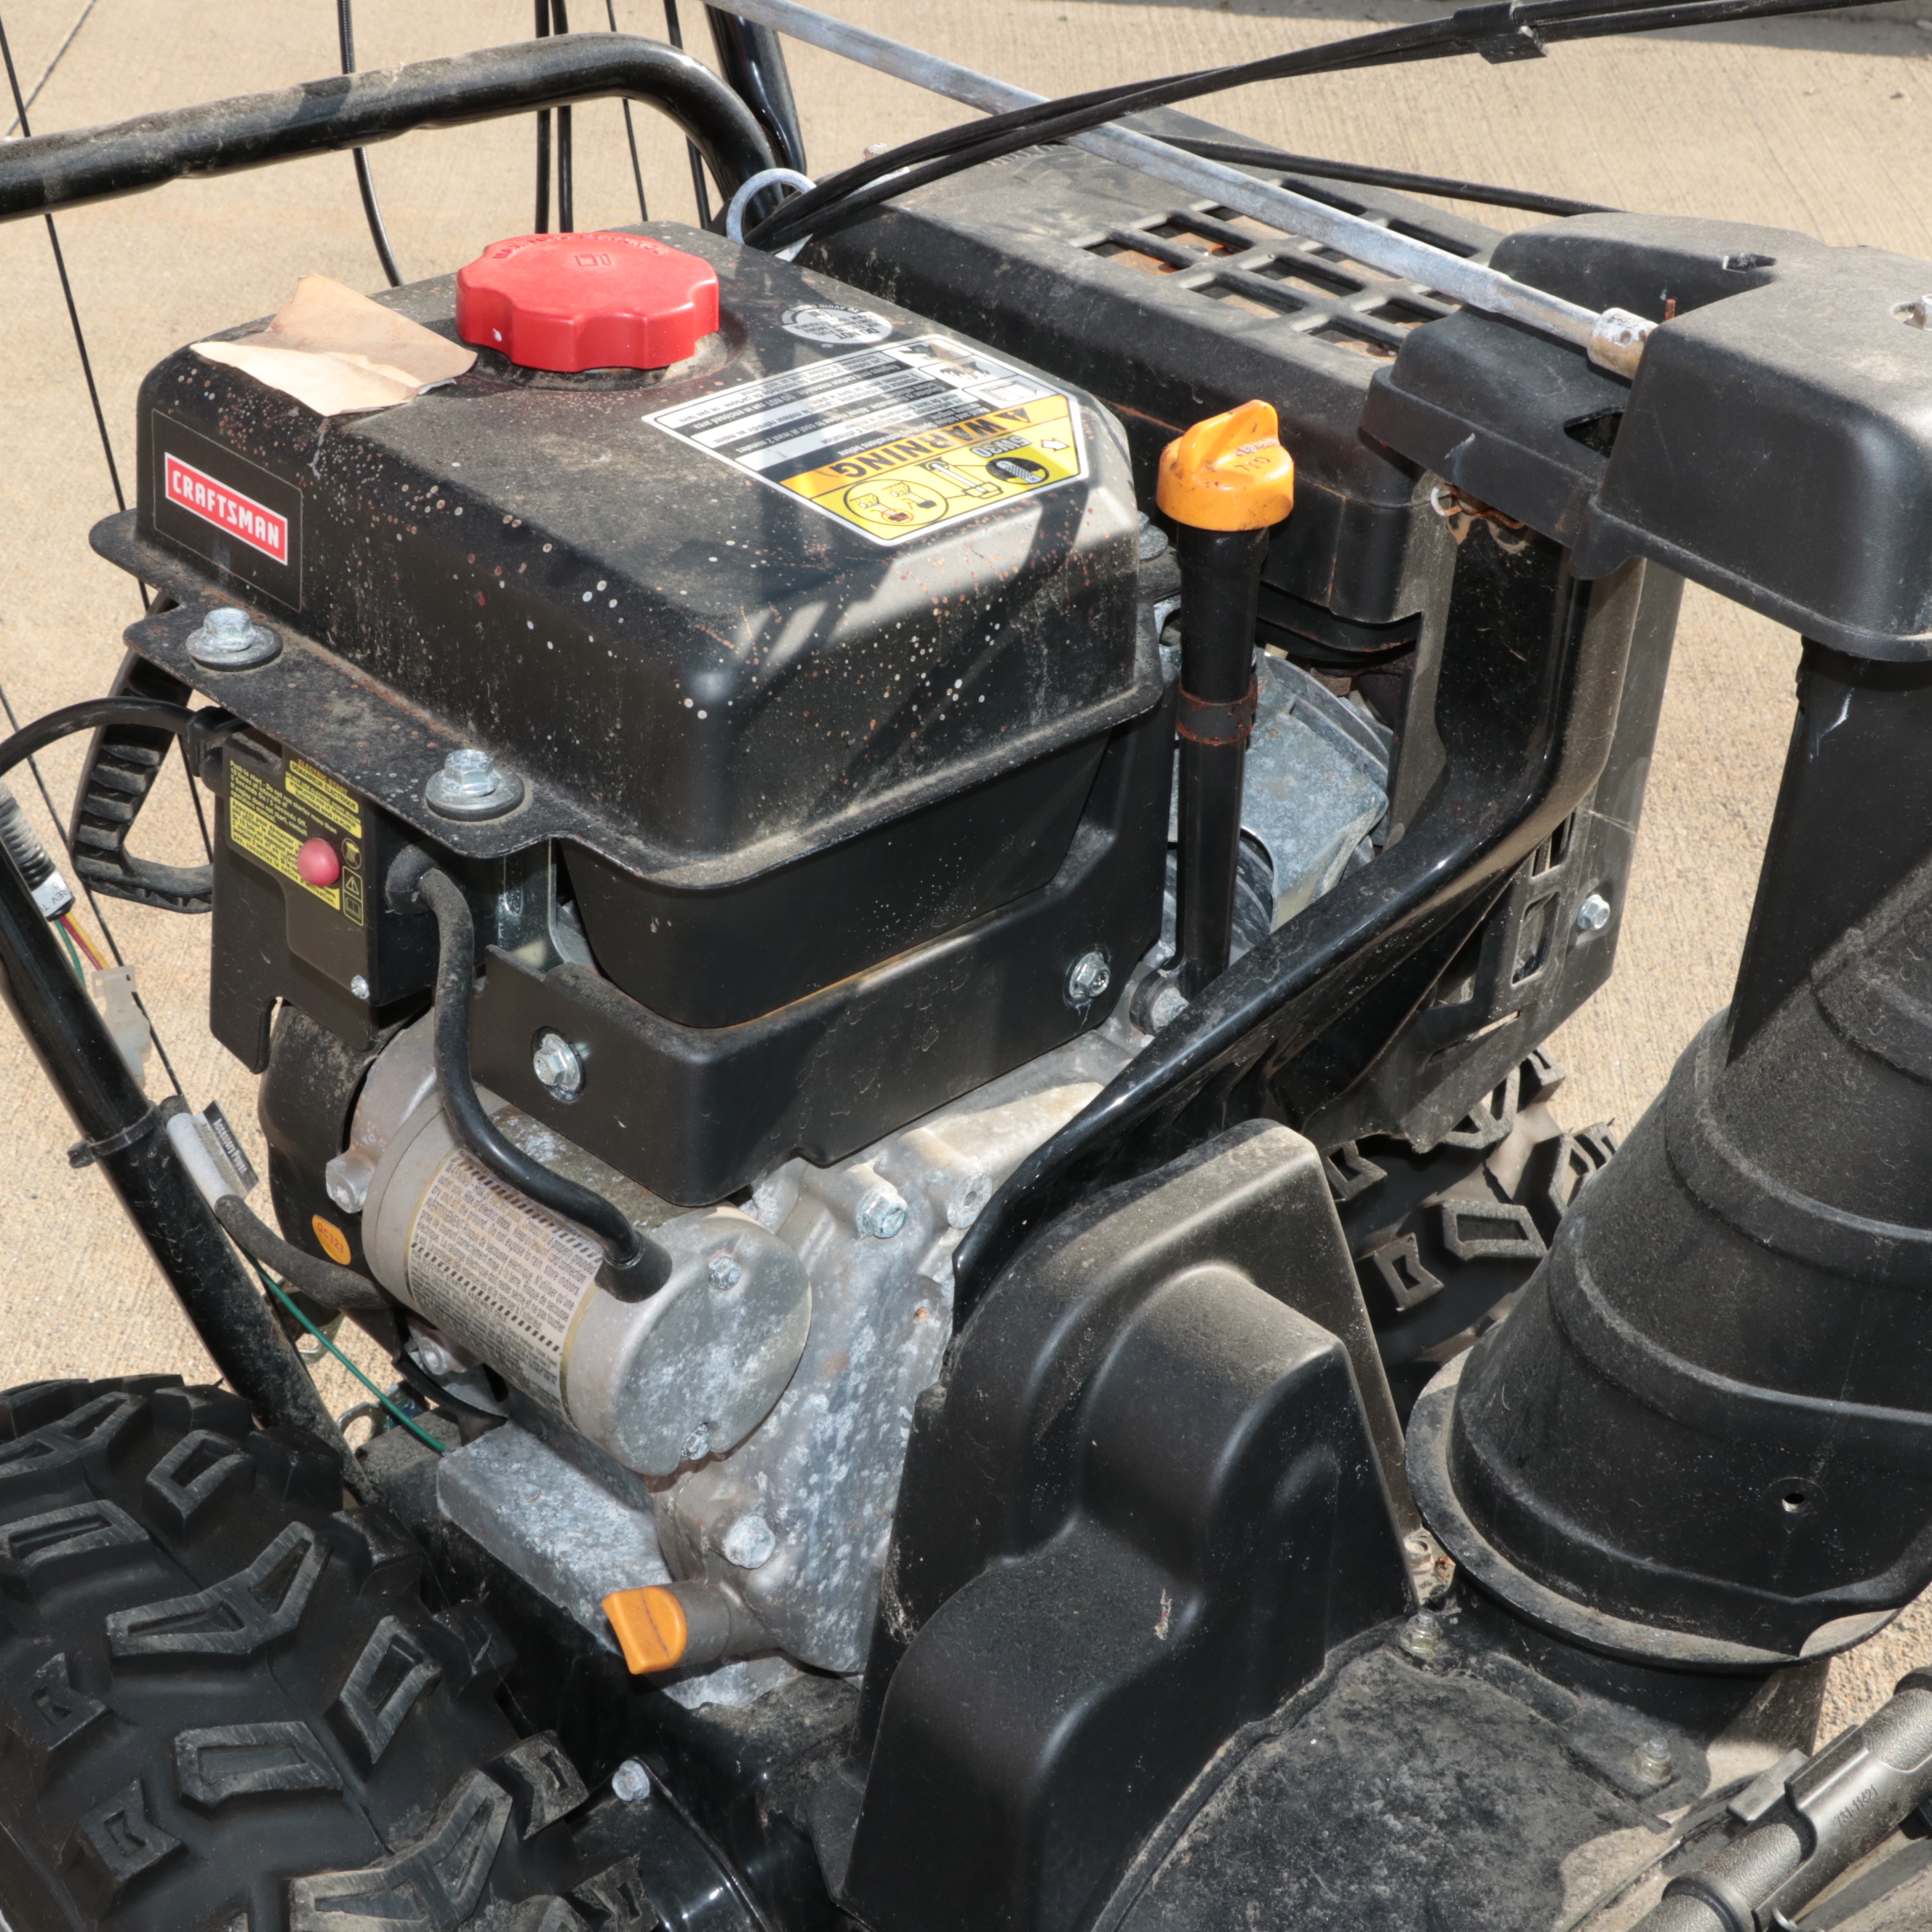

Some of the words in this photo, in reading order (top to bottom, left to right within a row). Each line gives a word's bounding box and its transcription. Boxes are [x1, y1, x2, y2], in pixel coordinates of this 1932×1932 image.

[831, 375, 855, 385] carbon
[765, 398, 783, 406] NOT
[969, 407, 990, 415] Read
[711, 410, 743, 423] enclosed
[777, 412, 802, 422] moteur
[799, 423, 816, 431] cool
[823, 413, 849, 423] engine
[713, 434, 736, 443] moins
[735, 440, 766, 452] minutes
[772, 432, 793, 441] least
[830, 419, 1007, 477] WARNING
[970, 435, 1030, 458] 5W30
[838, 445, 863, 455] before
[1234, 457, 1270, 471] OIL
[173, 471, 279, 548] CRAFTSMAN
[237, 772, 251, 785] times
[259, 786, 280, 804] intervals
[292, 775, 300, 784] NOT
[301, 782, 309, 790] USE
[311, 788, 330, 805] ELECTRIC
[298, 759, 326, 781] ELECTRIC
[328, 779, 347, 796] START
[230, 760, 242, 772] Push
[250, 774, 262, 785] start
[266, 783, 273, 792] Do
[274, 789, 282, 798] not
[283, 796, 292, 804] run
[293, 802, 309, 815] starter
[311, 814, 323, 825] more
[324, 822, 336, 834] than
[235, 777, 257, 795] Seconds
[258, 792, 266, 801] On
[274, 804, 295, 821] seconds
[316, 798, 324, 806] PAS
[232, 807, 241, 815] pas
[232, 801, 254, 818] Appuyez
[256, 817, 267, 826] pour
[235, 786, 250, 799] engine
[252, 797, 263, 808] does
[265, 805, 273, 814] not
[289, 821, 307, 836] consult
[321, 807, 332, 817] SOUS
[237, 824, 263, 843] secondes
[246, 842, 271, 862] consultez
[281, 866, 298, 879] notice
[52, 887, 71, 905] REV
[212, 1118, 236, 1154] Accessory
[231, 1149, 248, 1173] Power
[317, 1222, 344, 1253] QC323
[431, 1185, 441, 1199] dry
[440, 1191, 452, 1204] and
[458, 1204, 468, 1216] the
[487, 1224, 497, 1236] Do
[495, 1231, 506, 1242] not
[505, 1238, 524, 1256] expose
[524, 1249, 531, 1260] to
[543, 1265, 559, 1280] store
[463, 1192, 474, 1203] Risk
[473, 1199, 482, 1208] of
[479, 1204, 497, 1221] electric
[558, 1261, 586, 1282] connection
[479, 1236, 487, 1248] de
[486, 1242, 508, 1262] secousse
[547, 1237, 554, 1245] a
[551, 1240, 572, 1259] properly
[571, 1254, 596, 1274] grounded
[432, 1218, 439, 1228] de
[439, 1224, 457, 1240] courant
[523, 1280, 539, 1300] Risque
[539, 1294, 547, 1305] de
[546, 1301, 568, 1320] secousse
[412, 1250, 420, 1258] FOR
[422, 1257, 444, 1277] ELECTRIC
[446, 1274, 466, 1292] STARTER
[468, 1291, 492, 1312] ASSEMBLY
[494, 1309, 506, 1322] ONLY
[440, 1237, 447, 1248] La
[498, 1280, 511, 1293] rester
[525, 1298, 531, 1308] et
[530, 1302, 538, 1313] ne
[536, 1308, 546, 1320] pas
[546, 1314, 564, 1331] toucher
[1834, 1784, 1878, 1827] 731-11421
